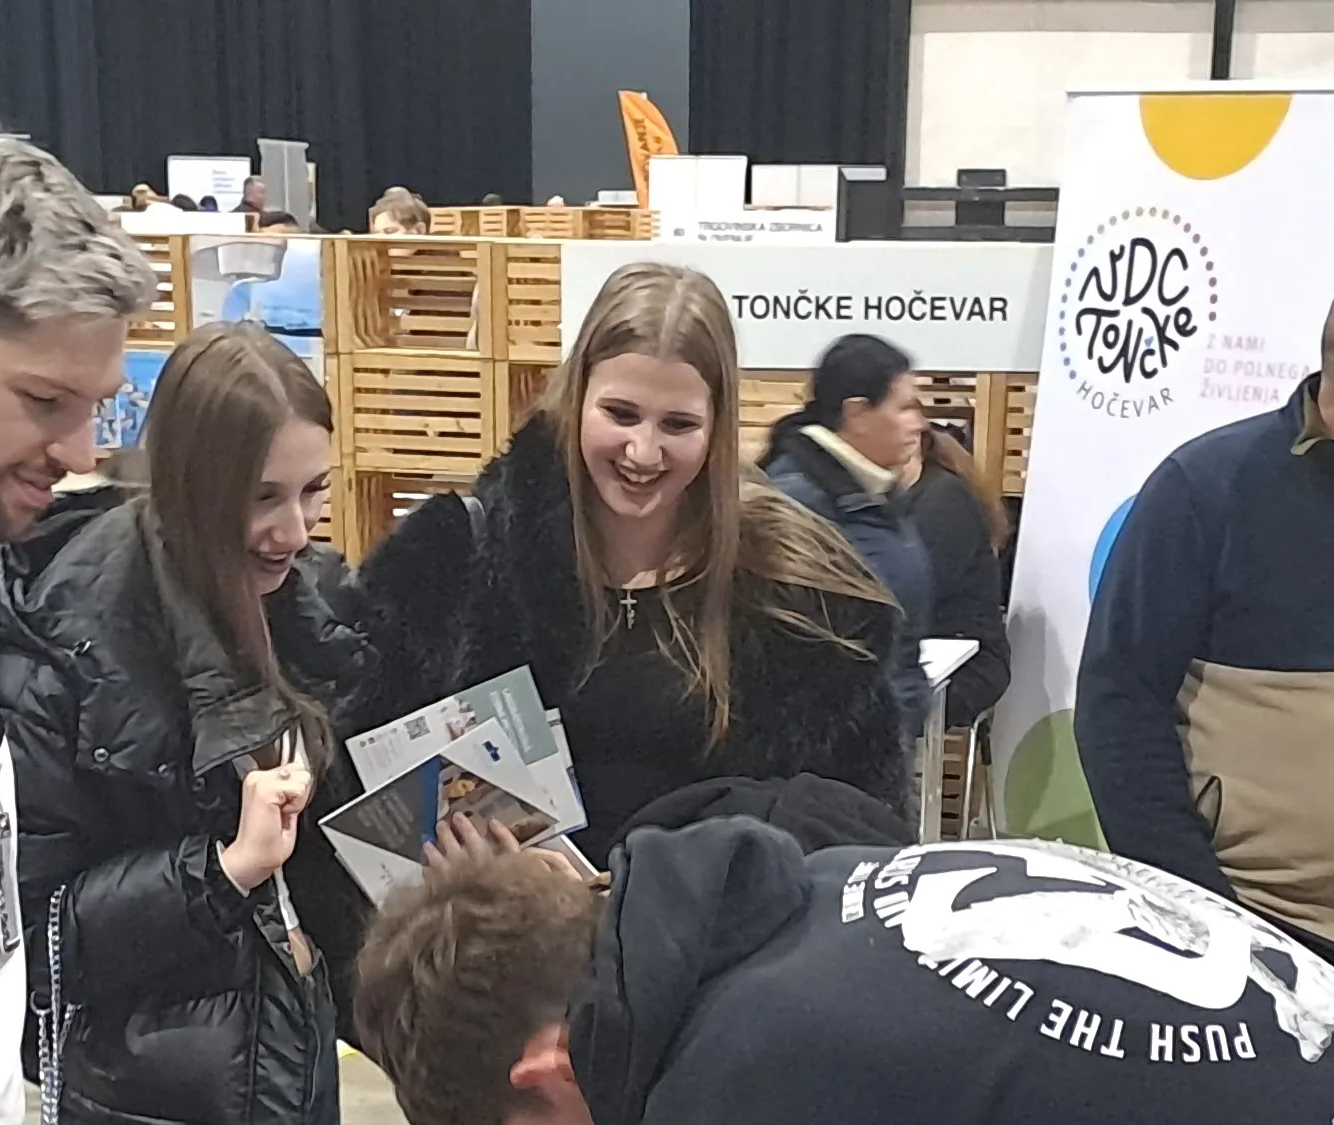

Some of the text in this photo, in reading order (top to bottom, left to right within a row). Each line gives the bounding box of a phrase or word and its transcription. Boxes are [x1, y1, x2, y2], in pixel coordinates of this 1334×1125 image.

[731, 289, 1008, 321] TONČKE HOČEVAR
[1223, 334, 1266, 352] NAMI
[1203, 358, 1227, 374] DO
[1076, 380, 1174, 418] HOČEVAR
[1039, 999, 1127, 1060] THE
[1149, 1021, 1258, 1063] PUSH
